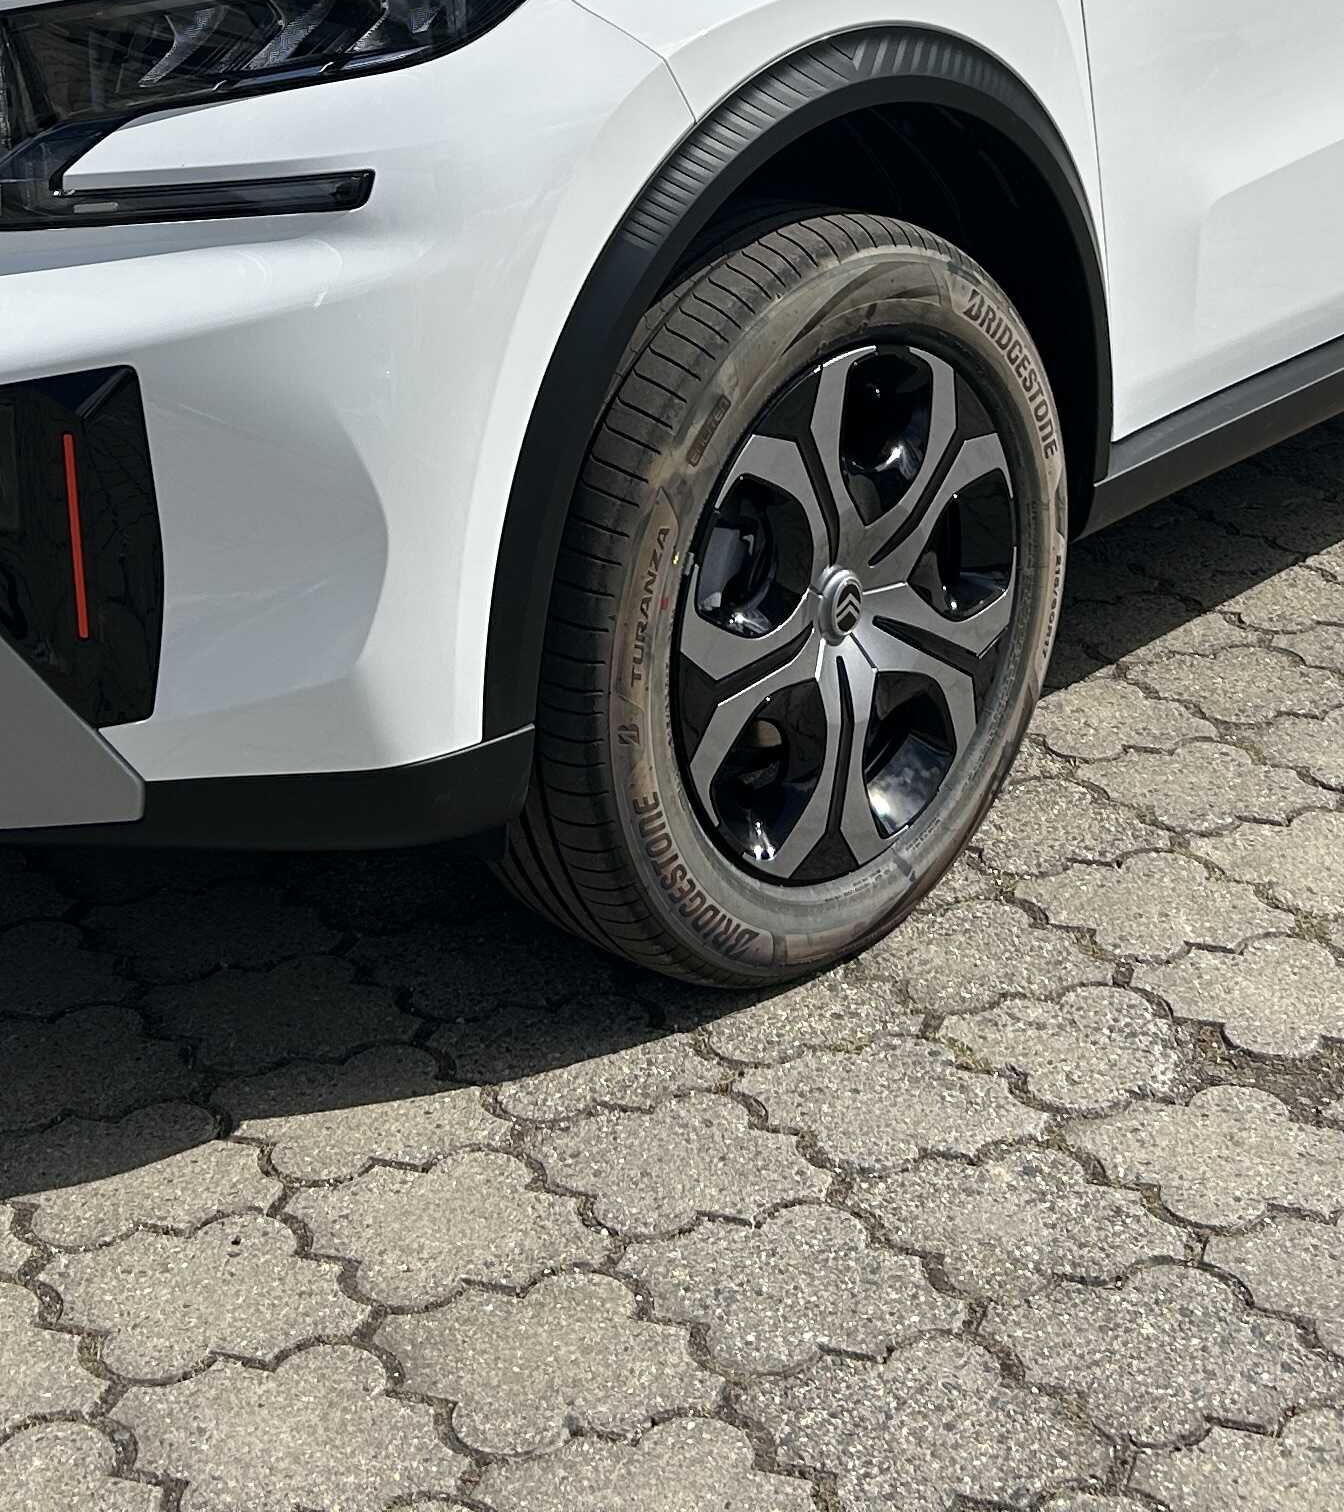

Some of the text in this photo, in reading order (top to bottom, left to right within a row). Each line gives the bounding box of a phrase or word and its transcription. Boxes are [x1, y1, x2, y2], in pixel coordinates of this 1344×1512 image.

[963, 288, 1059, 460] BRIDGESTONE
[630, 526, 671, 688] TURANZA
[632, 791, 761, 961] BRIDGESTONE
